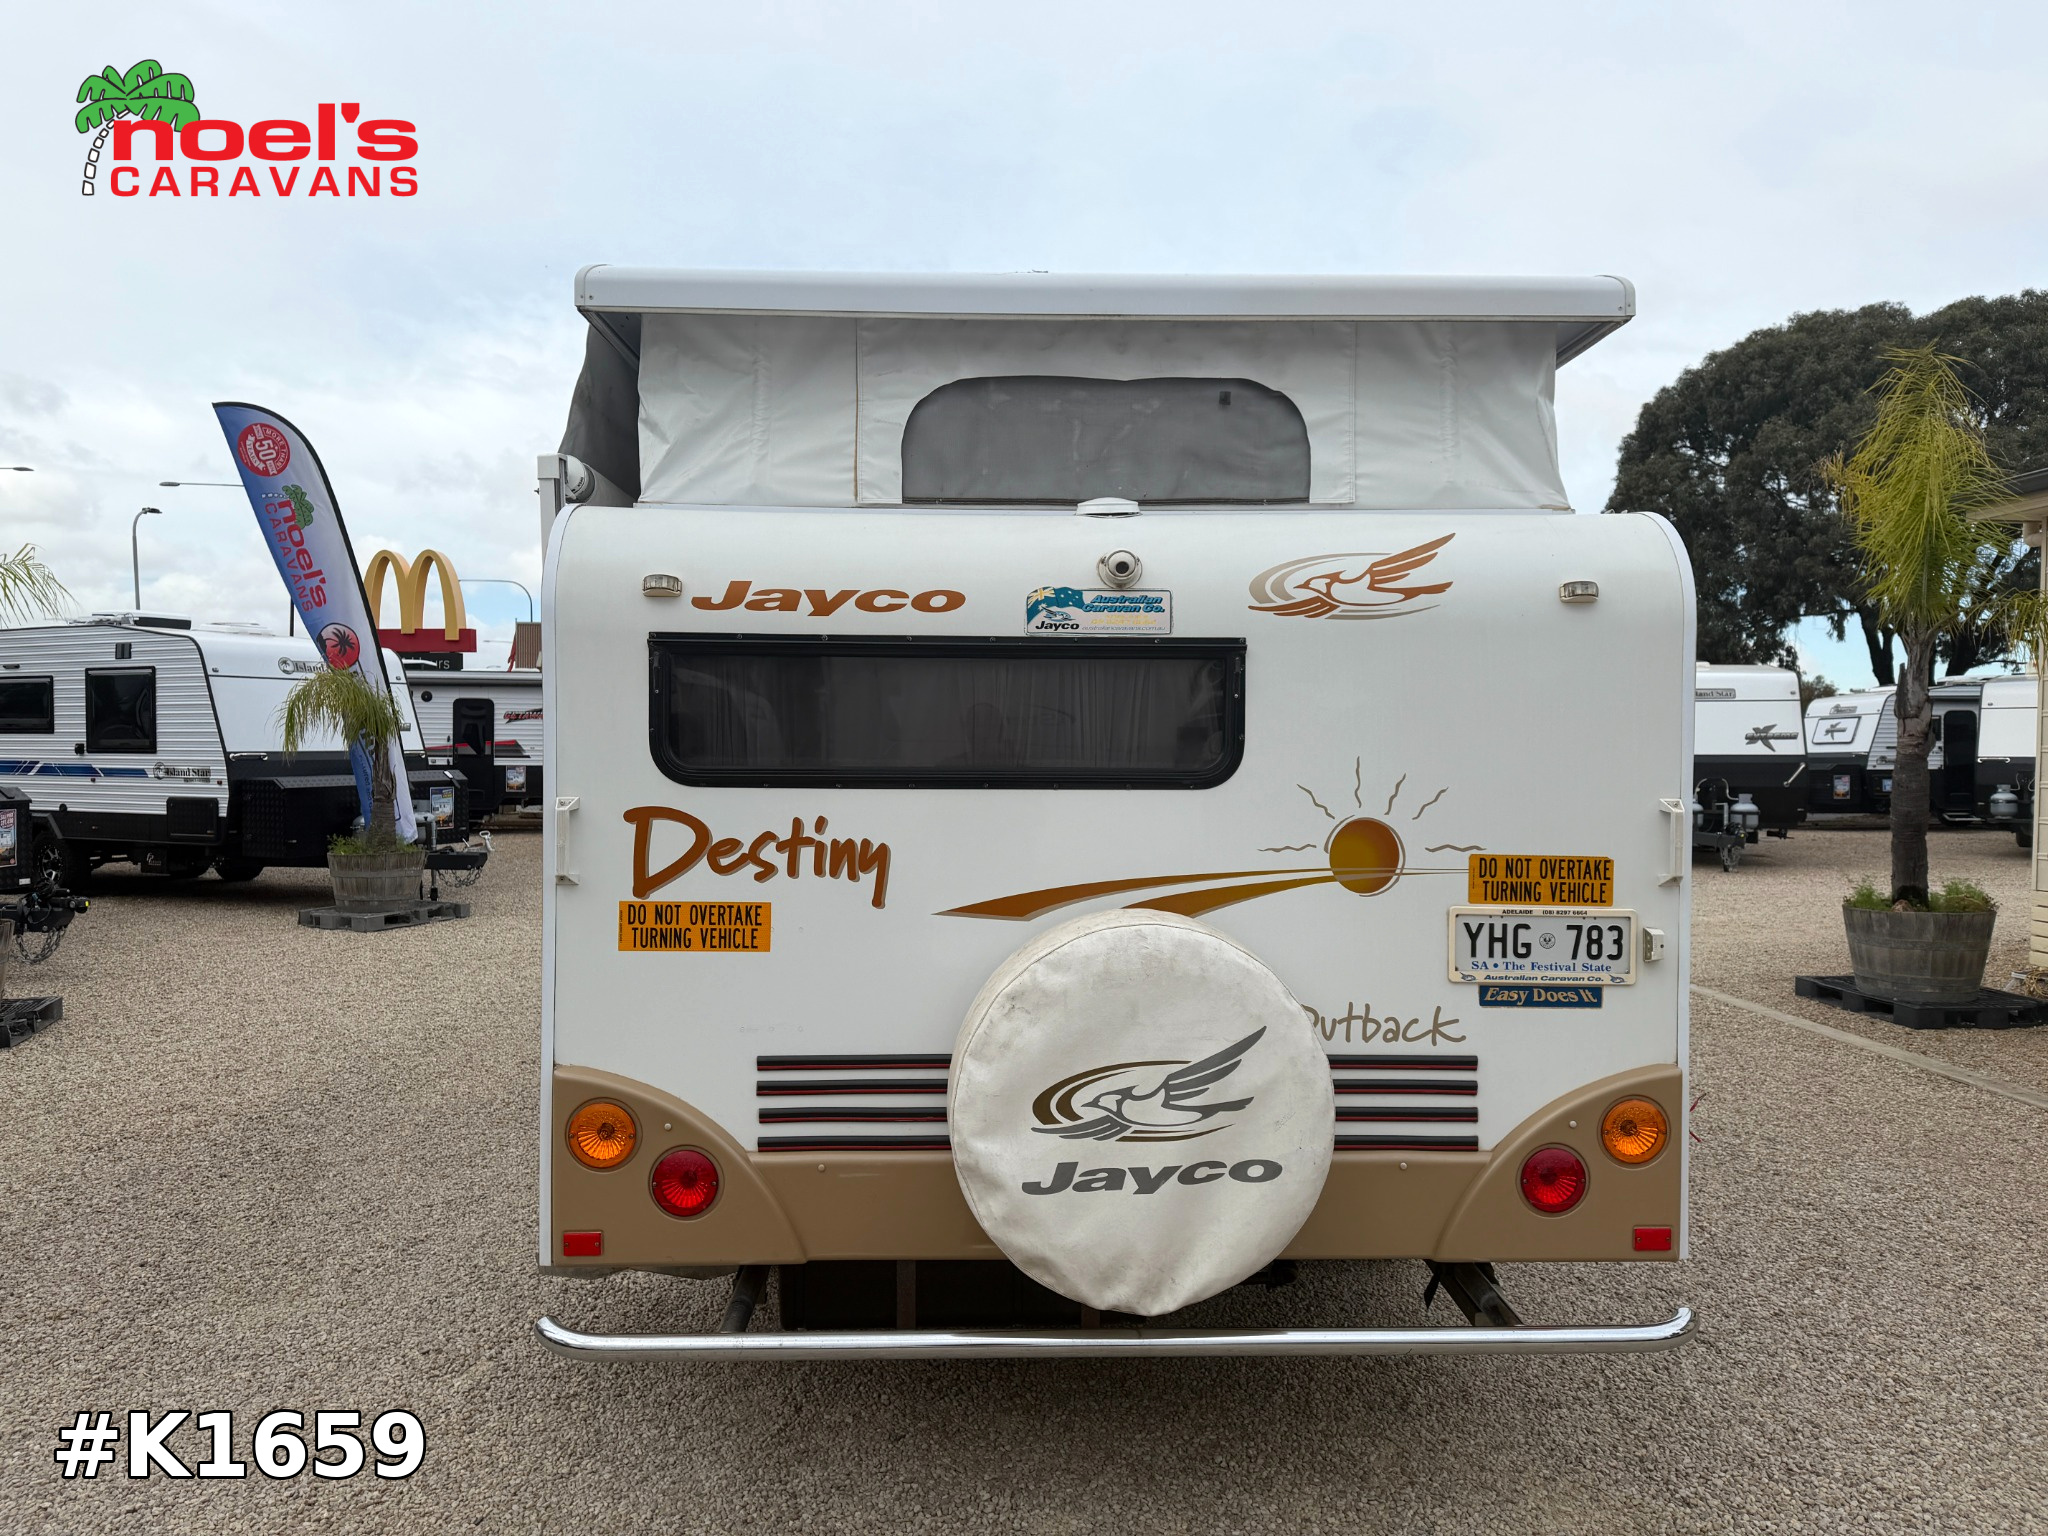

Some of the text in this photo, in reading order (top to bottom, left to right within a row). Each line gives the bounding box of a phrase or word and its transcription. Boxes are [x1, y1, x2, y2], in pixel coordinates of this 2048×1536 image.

[255, 440, 276, 460] 50
[265, 503, 314, 612] CARAVANS
[277, 499, 327, 608] noel's
[691, 580, 966, 617] Jayco
[1081, 603, 1166, 613] Caravan Co.
[1090, 594, 1163, 604] Australian
[1035, 620, 1080, 632] Jayco
[623, 805, 891, 909] Destiny
[1479, 858, 1498, 879] DO
[1505, 858, 1532, 879] NOT
[1539, 859, 1611, 881] OVERTAKE
[1482, 880, 1607, 904] TURNING VEHICLE
[627, 904, 763, 927] DO NOT OVERTAKE
[632, 927, 758, 949] TURNING VEHICLE
[1463, 922, 1623, 961] YHG 783
[1471, 960, 1612, 972] SA The Festival State
[1484, 974, 1538, 982] Australian
[1484, 987, 1598, 1006] Easy Does It
[1021, 1158, 1283, 1196] Jayco
